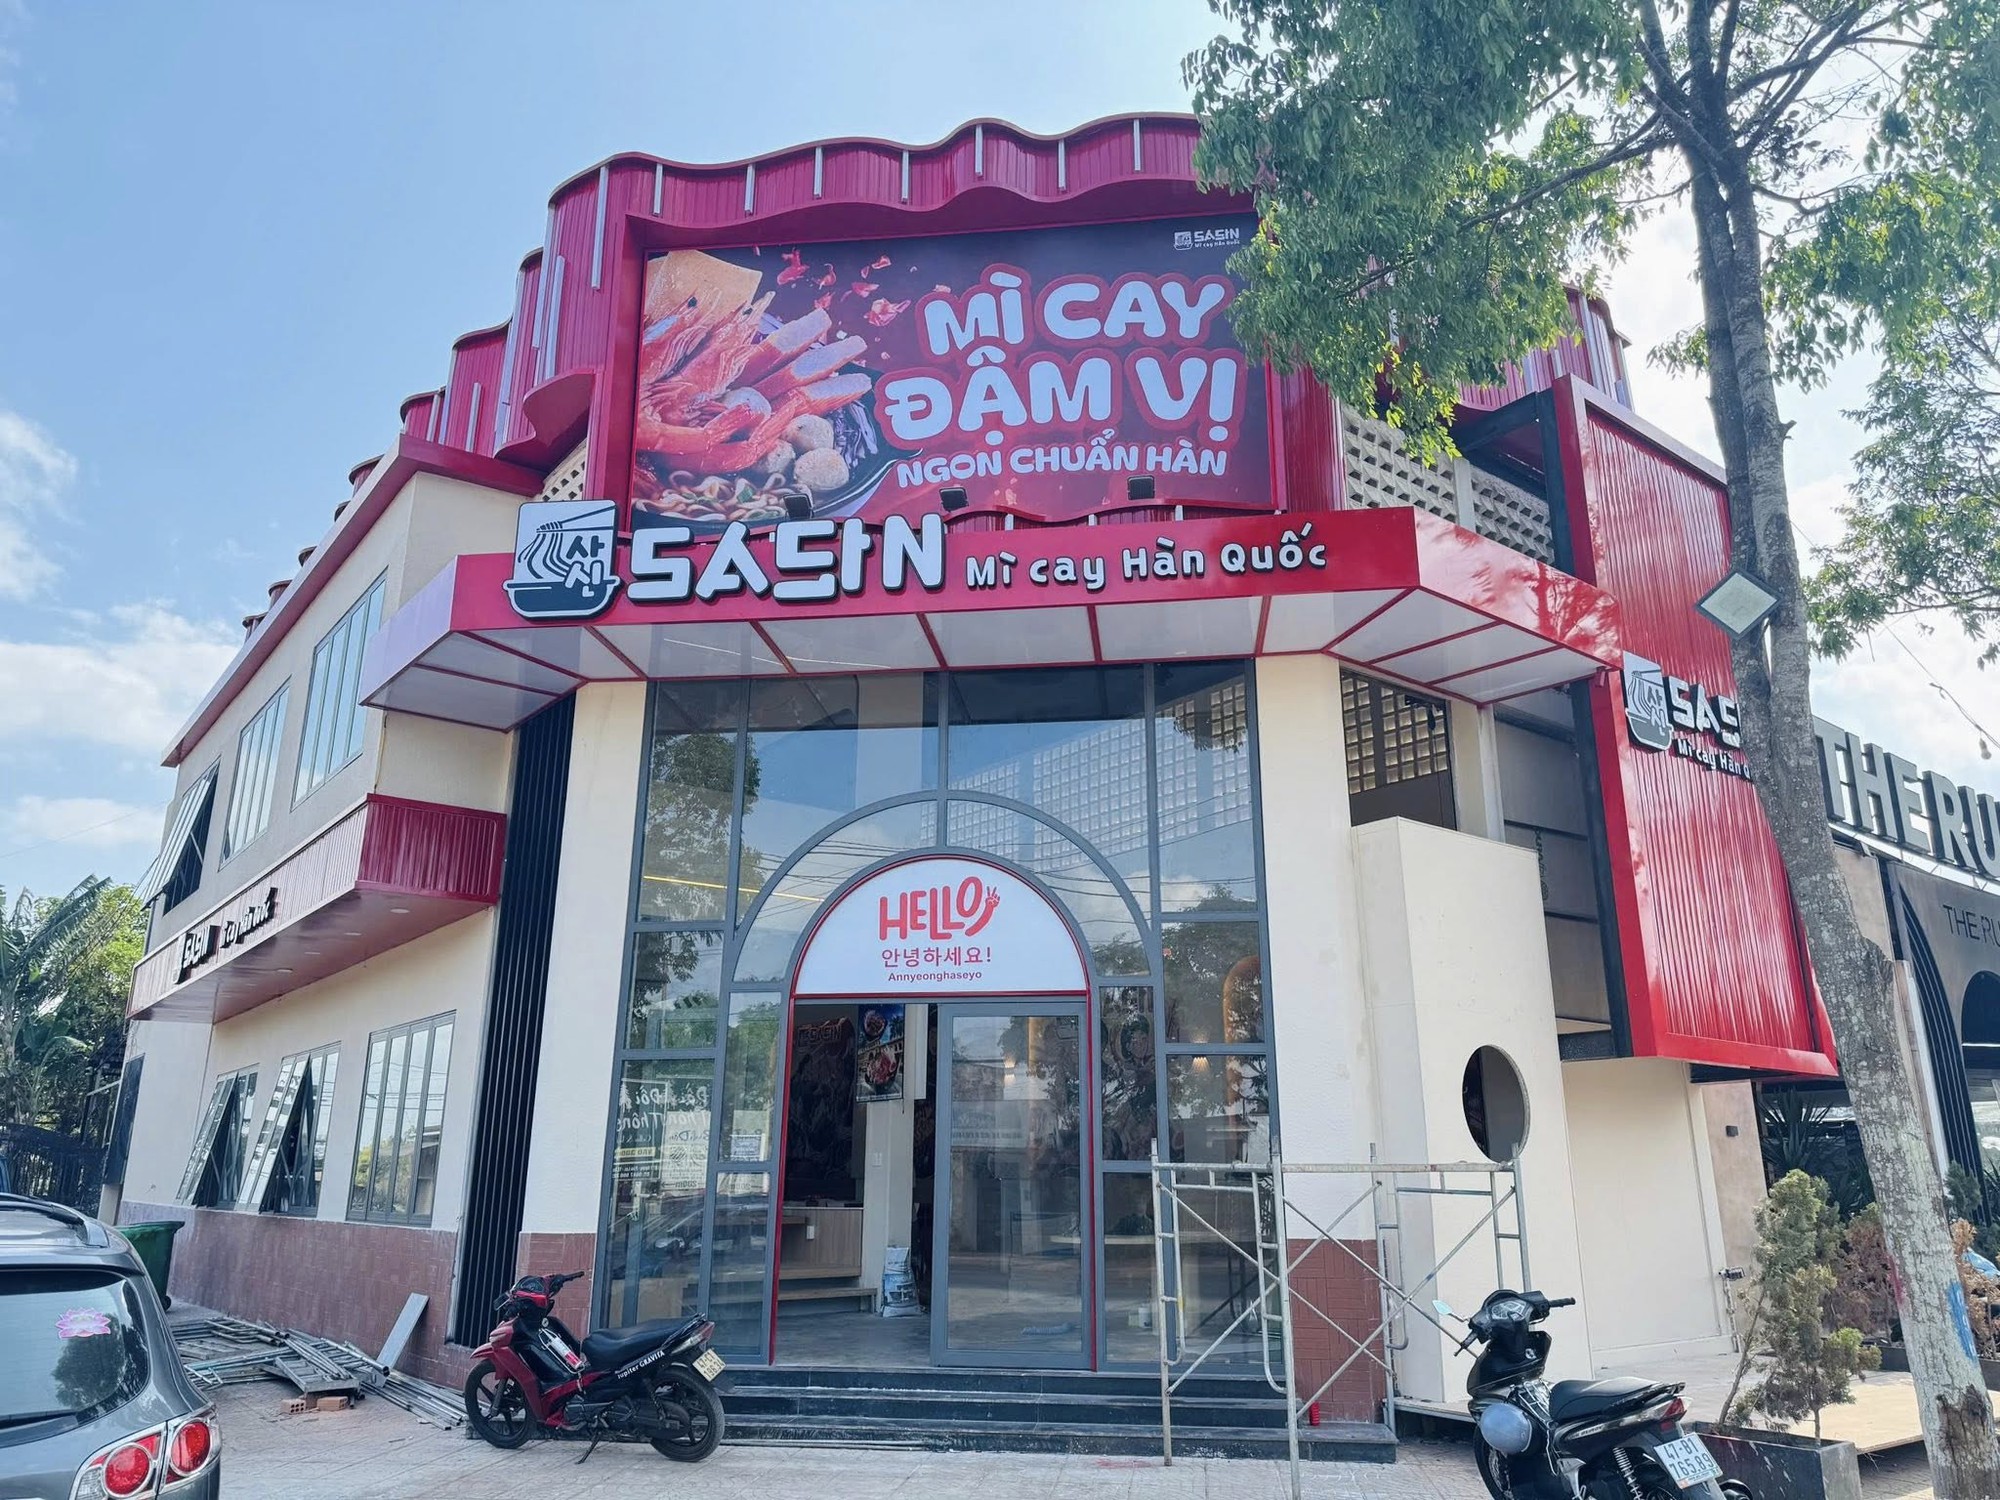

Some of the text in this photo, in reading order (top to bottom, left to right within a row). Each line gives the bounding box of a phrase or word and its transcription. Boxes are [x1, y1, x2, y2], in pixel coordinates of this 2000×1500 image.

[1194, 228, 1240, 241] SASIN
[925, 271, 1225, 355] MÌ CAY
[885, 346, 1236, 445] ĐẬM VỊ
[897, 428, 1227, 488] NGON CHUẨN HÀN
[626, 513, 946, 602] SASIN
[966, 521, 1327, 590] Mì cay Hàn Quốc
[1668, 676, 1742, 749] SAS
[1696, 749, 1717, 770] cay
[1720, 750, 1741, 774] Hàn
[1816, 716, 1931, 854] THE
[879, 876, 985, 941] HELLO
[1943, 904, 1979, 940] THE
[881, 946, 992, 968] 안녕하세요!
[888, 970, 982, 982] Annyeonghaseyo
[1664, 1437, 1700, 1461] 47-B1
[1668, 1453, 1715, 1480] 765.89
